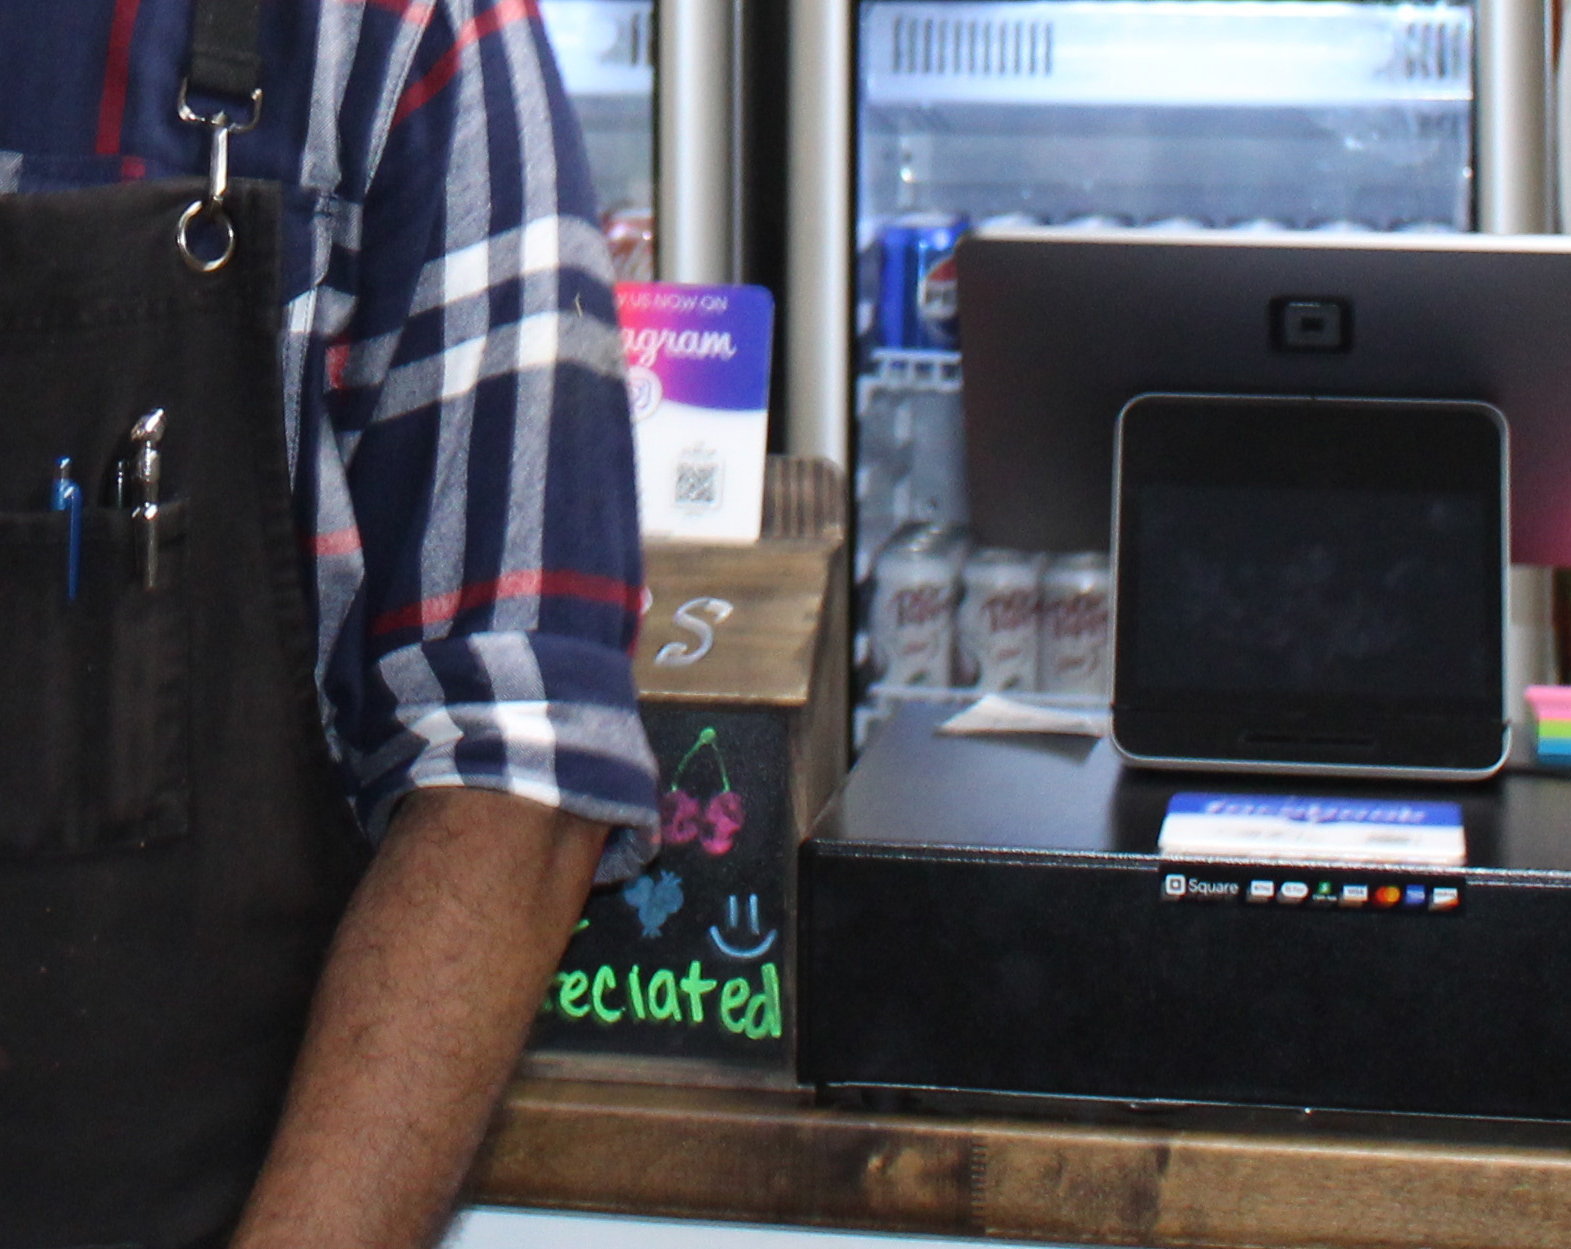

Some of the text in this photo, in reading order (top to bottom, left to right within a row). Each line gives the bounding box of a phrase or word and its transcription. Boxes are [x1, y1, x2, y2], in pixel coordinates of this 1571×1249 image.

[653, 293, 698, 312] NOW
[700, 295, 729, 312] ON
[641, 587, 734, 667] S
[1188, 877, 1239, 896] Square
